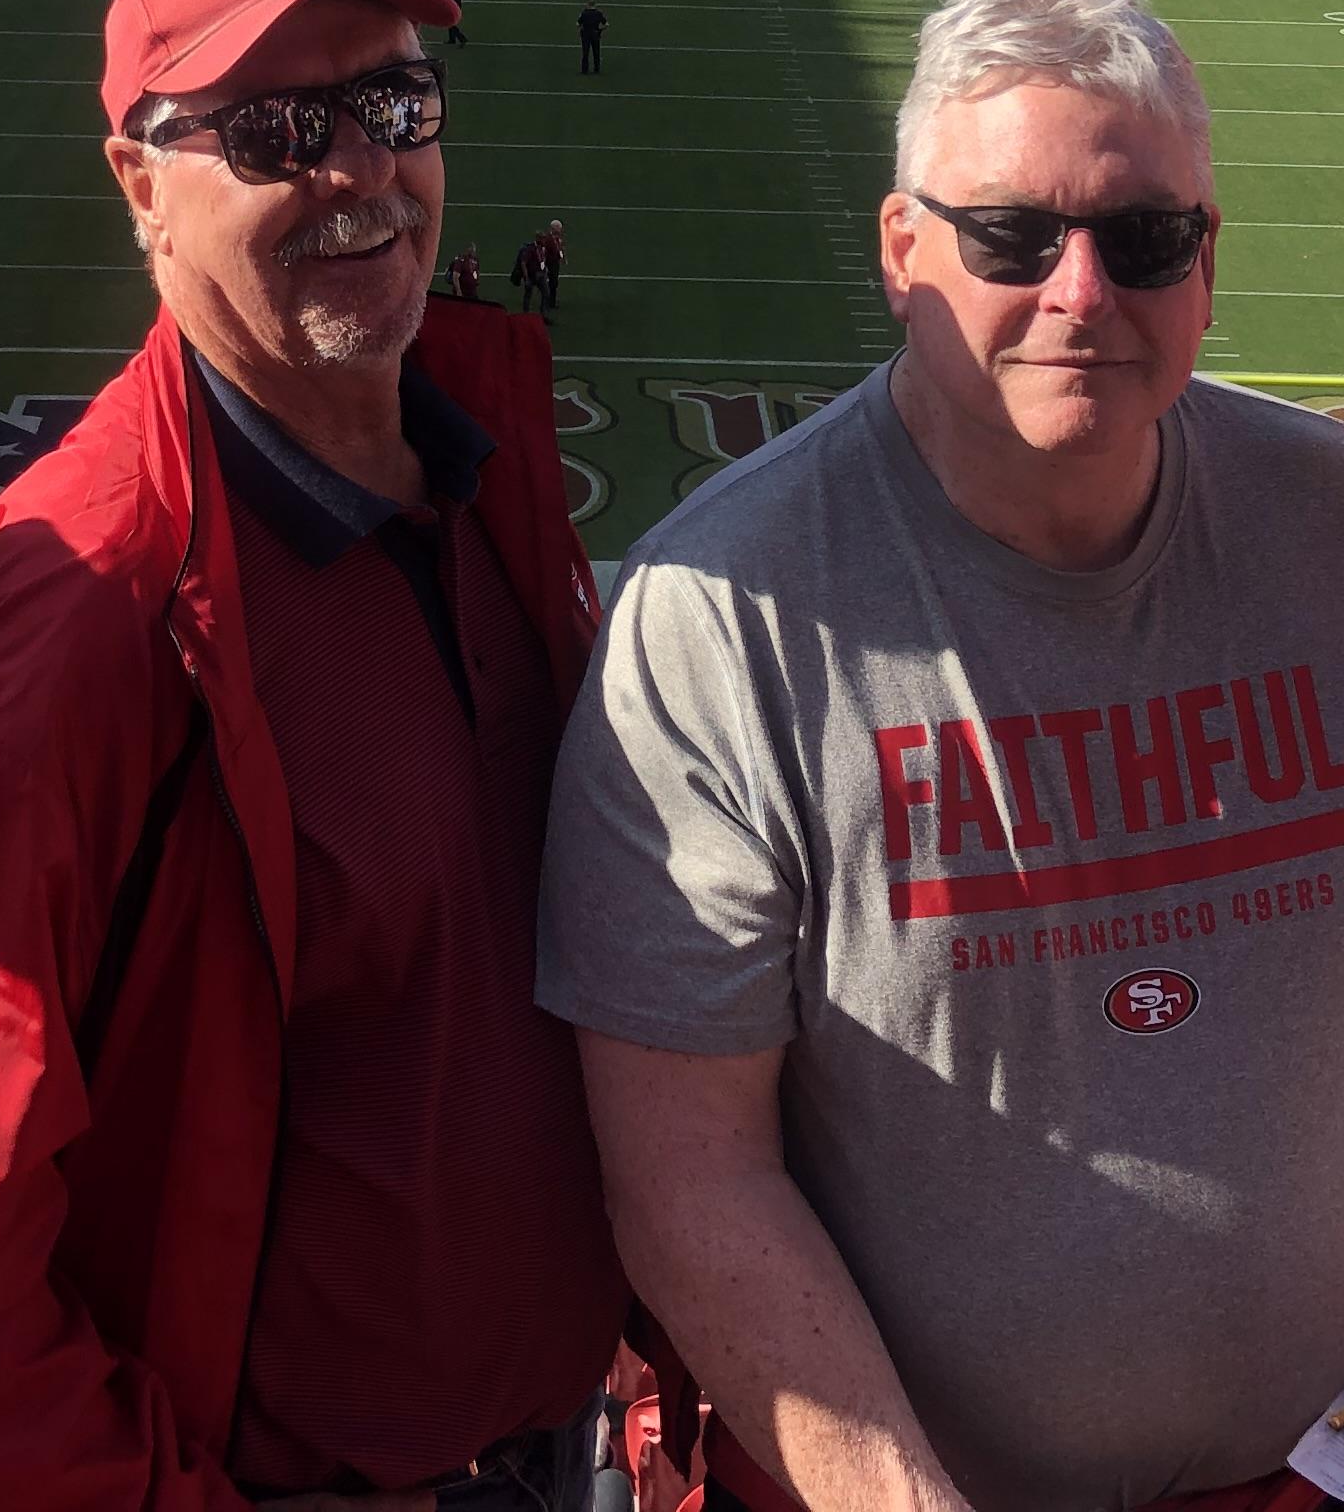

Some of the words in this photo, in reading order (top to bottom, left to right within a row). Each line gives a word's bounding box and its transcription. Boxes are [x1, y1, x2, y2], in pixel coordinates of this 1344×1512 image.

[952, 931, 1017, 971] SAN
[1033, 902, 1217, 960] FRANCISCO
[1232, 872, 1336, 927] 49ERS
[1127, 977, 1183, 1027] SF
